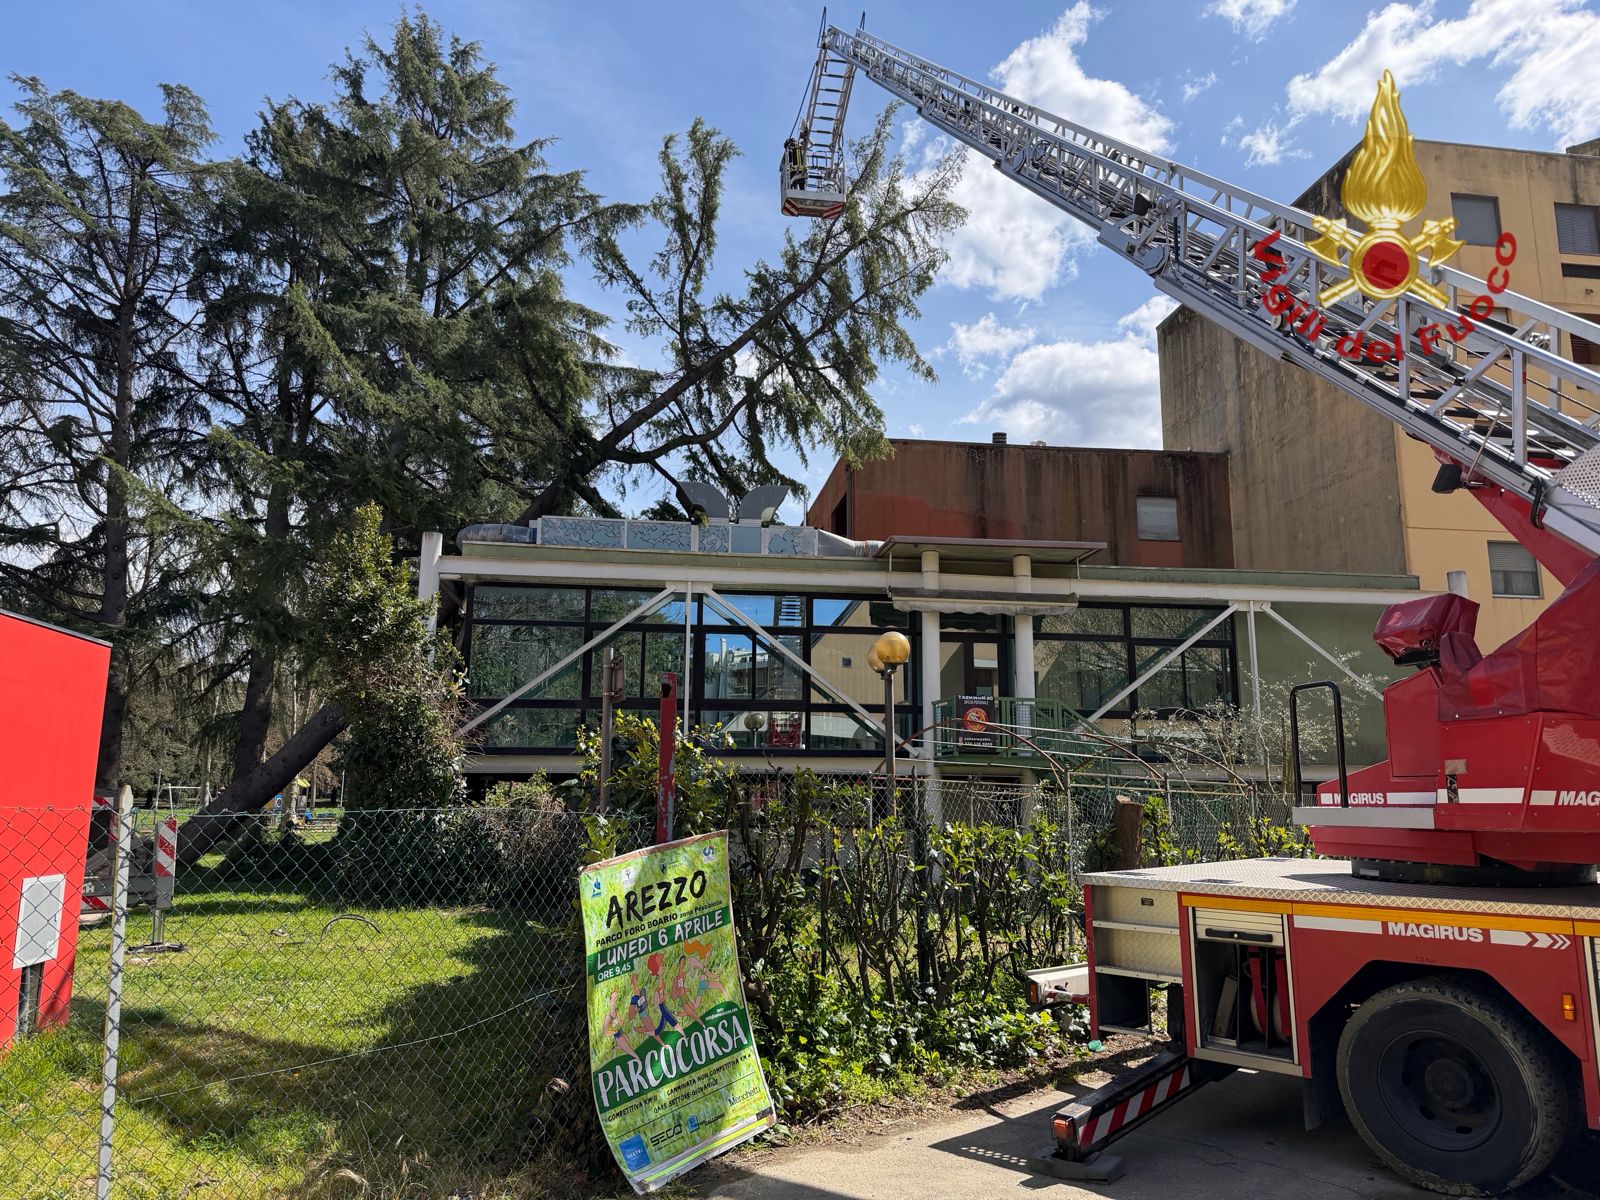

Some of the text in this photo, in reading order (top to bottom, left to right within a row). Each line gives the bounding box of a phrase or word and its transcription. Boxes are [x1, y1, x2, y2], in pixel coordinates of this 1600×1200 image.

[605, 870, 708, 929] AREZZO
[596, 931, 623, 948] PARCO
[624, 923, 646, 937] FORO
[647, 912, 678, 929] BOARIO
[679, 909, 694, 918] zona
[596, 910, 724, 971] LUNEDI 6 APRILE
[1388, 921, 1483, 943] MAGIRUS
[597, 968, 615, 982] ORE
[598, 1015, 748, 1108] PARCOCORSA
[666, 1078, 697, 1096] CAMMINATA
[709, 1058, 740, 1076] COMPETITIVA
[608, 1101, 643, 1122] COMPETITIVA
[668, 1092, 691, 1108] SETTORE
